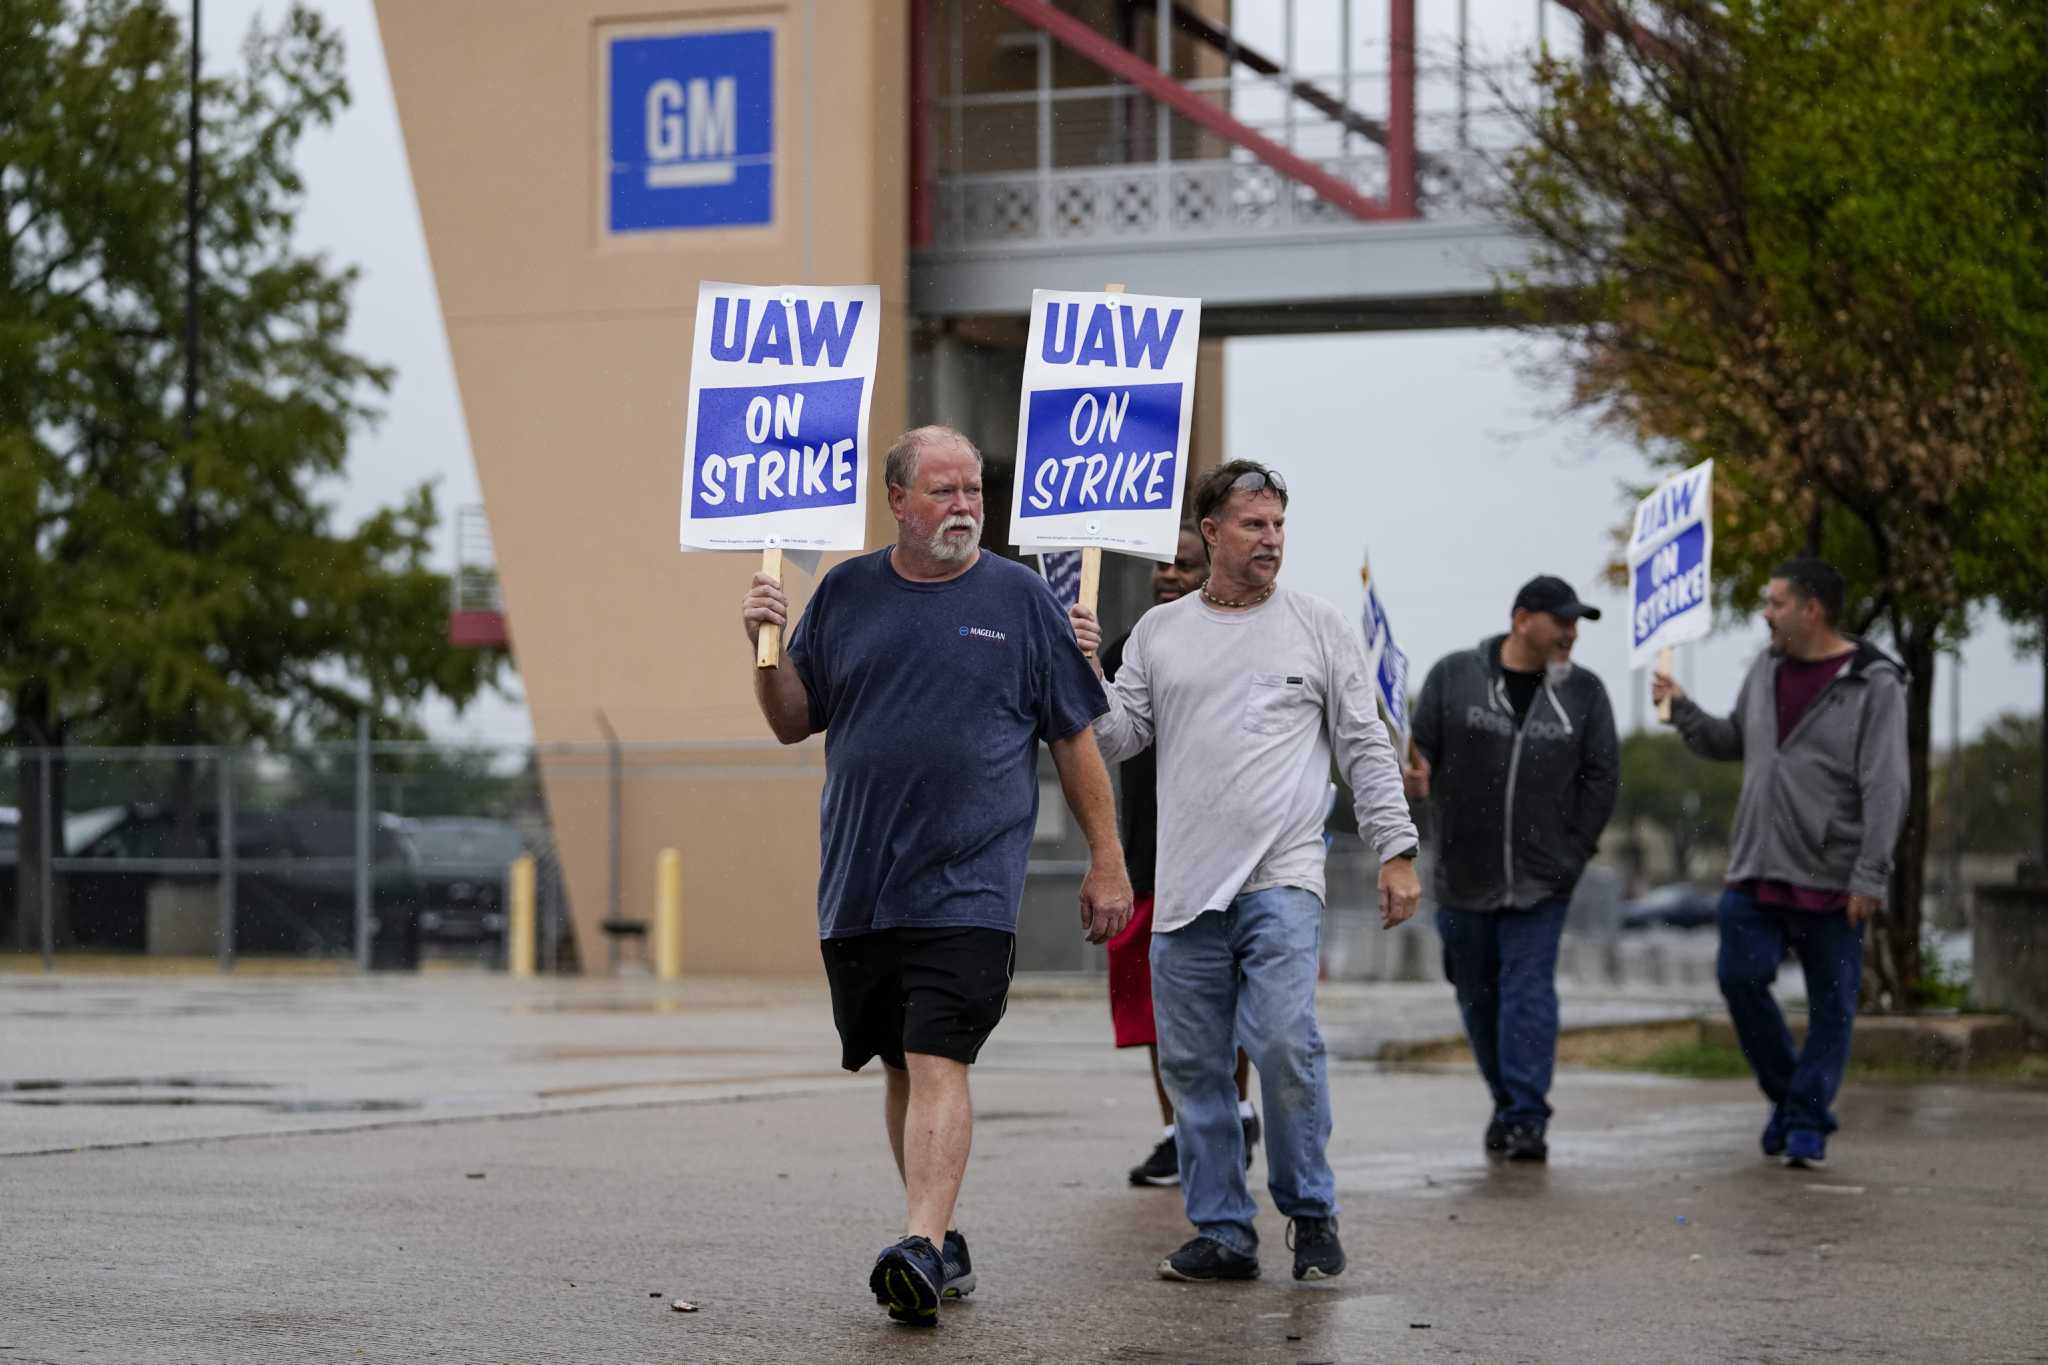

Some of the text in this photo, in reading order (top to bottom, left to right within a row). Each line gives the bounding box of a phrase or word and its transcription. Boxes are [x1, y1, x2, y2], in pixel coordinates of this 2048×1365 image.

[646, 77, 737, 160] GM
[710, 296, 864, 368] UAW
[1041, 302, 1184, 370] UAW
[745, 393, 804, 444] ON
[1069, 391, 1130, 446] ON
[700, 438, 854, 505] STRIKE
[1028, 451, 1174, 510] STRIKE
[1638, 470, 1702, 544] UAW
[1651, 541, 1680, 588] ON
[970, 626, 1006, 641] MAGELLAN
[1636, 562, 1703, 640] STRIKE
